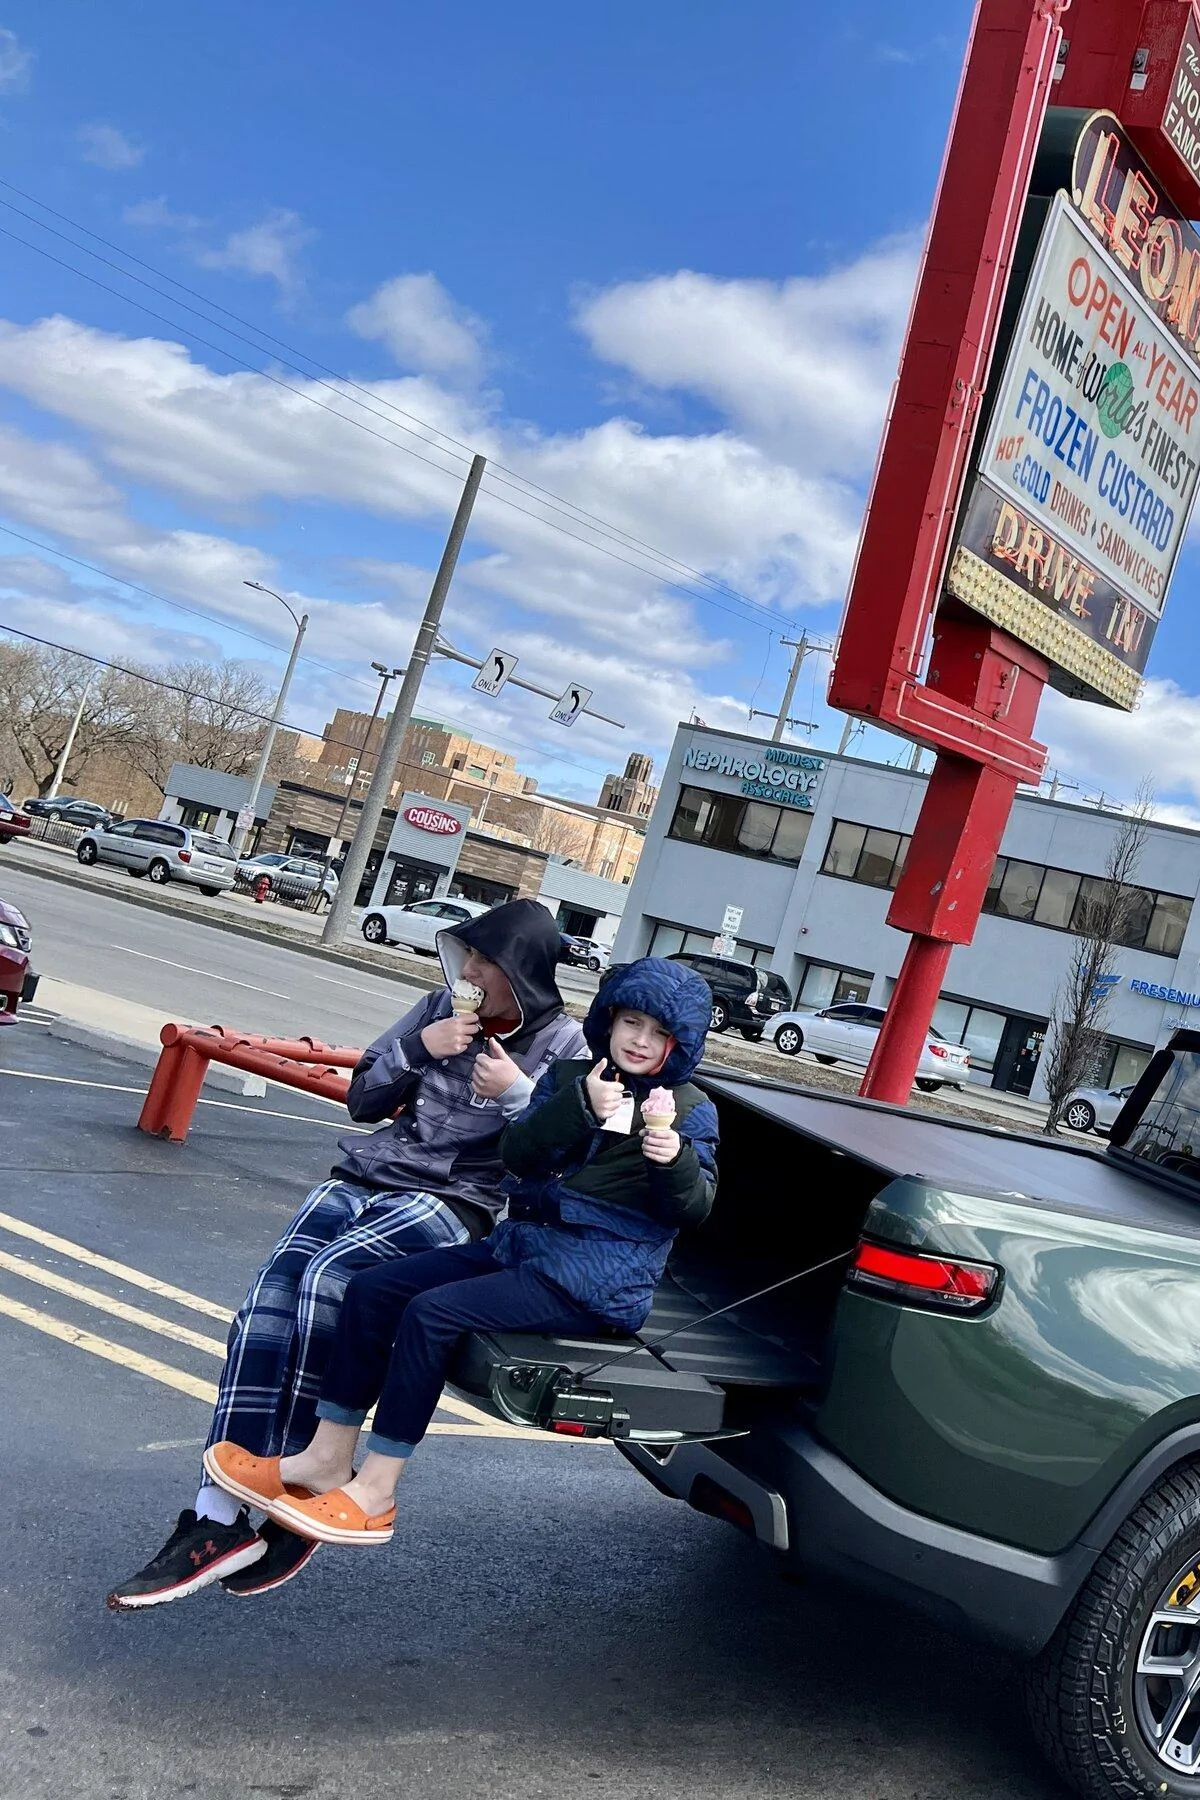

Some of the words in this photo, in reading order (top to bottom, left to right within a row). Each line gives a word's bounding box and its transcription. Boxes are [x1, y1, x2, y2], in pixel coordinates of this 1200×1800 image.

[1185, 42, 1200, 77] The
[1067, 257, 1136, 358] OPEN
[1132, 340, 1149, 360] ALL
[1144, 341, 1199, 434] YEAR
[1029, 296, 1083, 384] HOME
[1082, 352, 1149, 442] World's
[1141, 417, 1195, 498] FINEST
[995, 435, 1025, 461] HOT
[1015, 367, 1099, 484] FROZEN
[1098, 449, 1175, 552] CUSTARD
[1020, 454, 1051, 504] COLD
[1050, 480, 1091, 536] DRINKS
[1097, 521, 1164, 600] SANDWICHES
[991, 501, 1097, 619] DRIVE
[1105, 598, 1147, 653] IN
[478, 679, 498, 692] ONLY
[554, 710, 573, 722] ONLY
[682, 747, 817, 792] NEPHROLOGY
[765, 748, 824, 770] MIDWEST
[740, 780, 814, 808] ASSOCIATES
[408, 808, 457, 833] COUSINS
